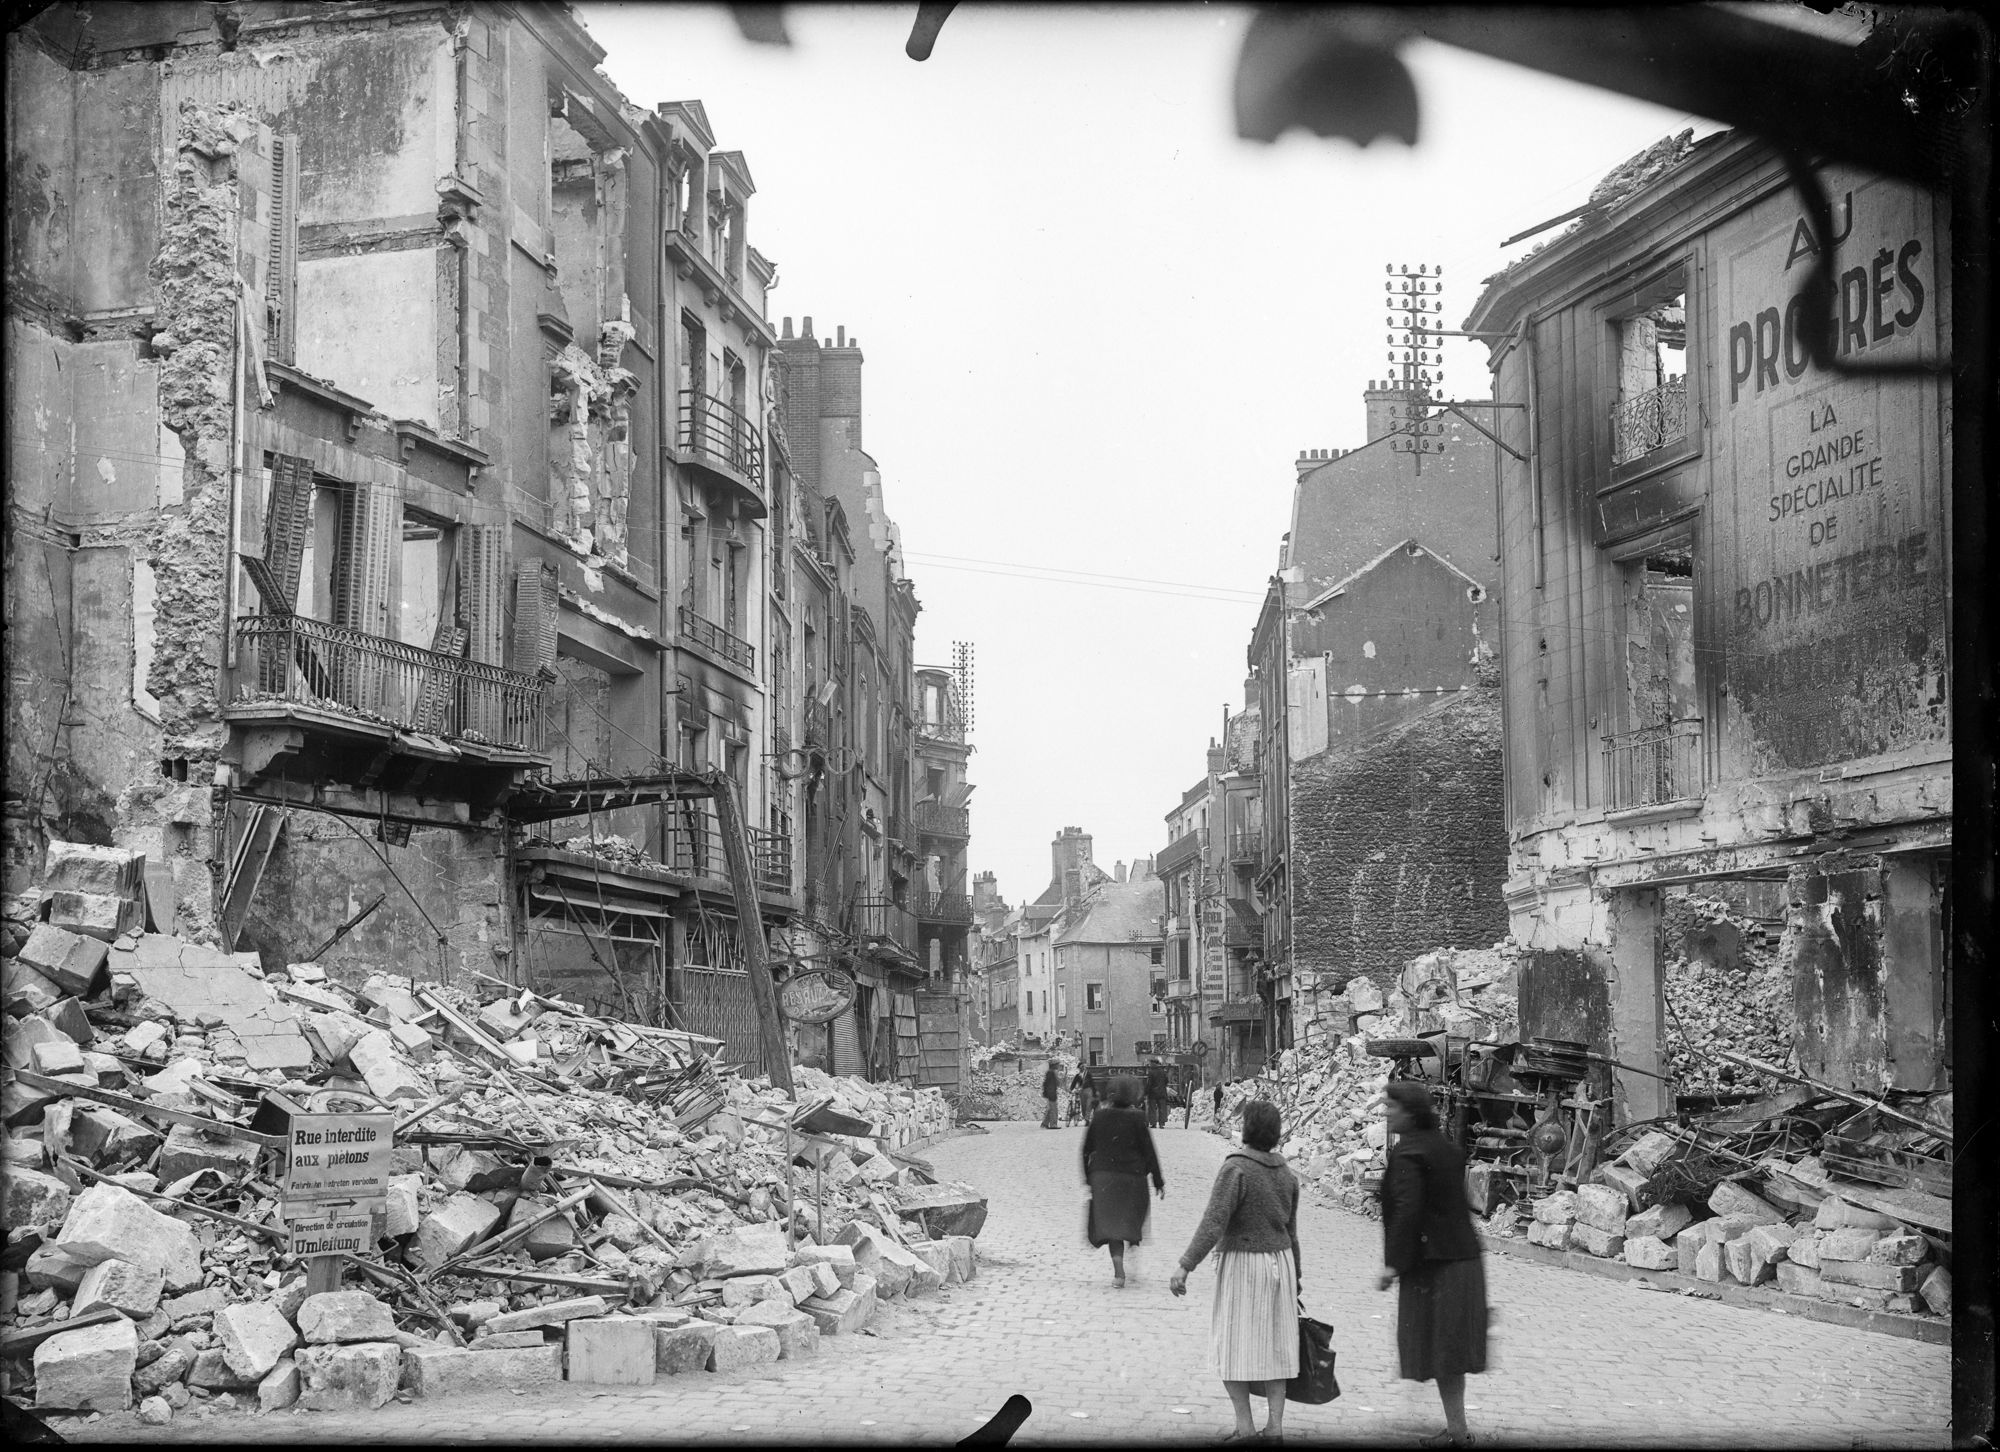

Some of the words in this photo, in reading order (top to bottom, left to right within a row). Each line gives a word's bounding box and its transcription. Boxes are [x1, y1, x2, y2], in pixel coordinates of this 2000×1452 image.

[1785, 191, 1853, 272] AU
[1810, 404, 1838, 433] LA
[1786, 429, 1864, 478] GRANDE
[1768, 457, 1883, 522] SPÉCIALITÉ
[1810, 516, 1838, 546] DE
[294, 1130, 322, 1145] Rue
[325, 1127, 377, 1143] interdite
[295, 1154, 320, 1167] aux
[291, 1182, 321, 1190] Fahrbhn
[295, 1222, 325, 1232] Direction
[326, 1220, 334, 1230] de
[294, 1236, 361, 1255] Umleitung
